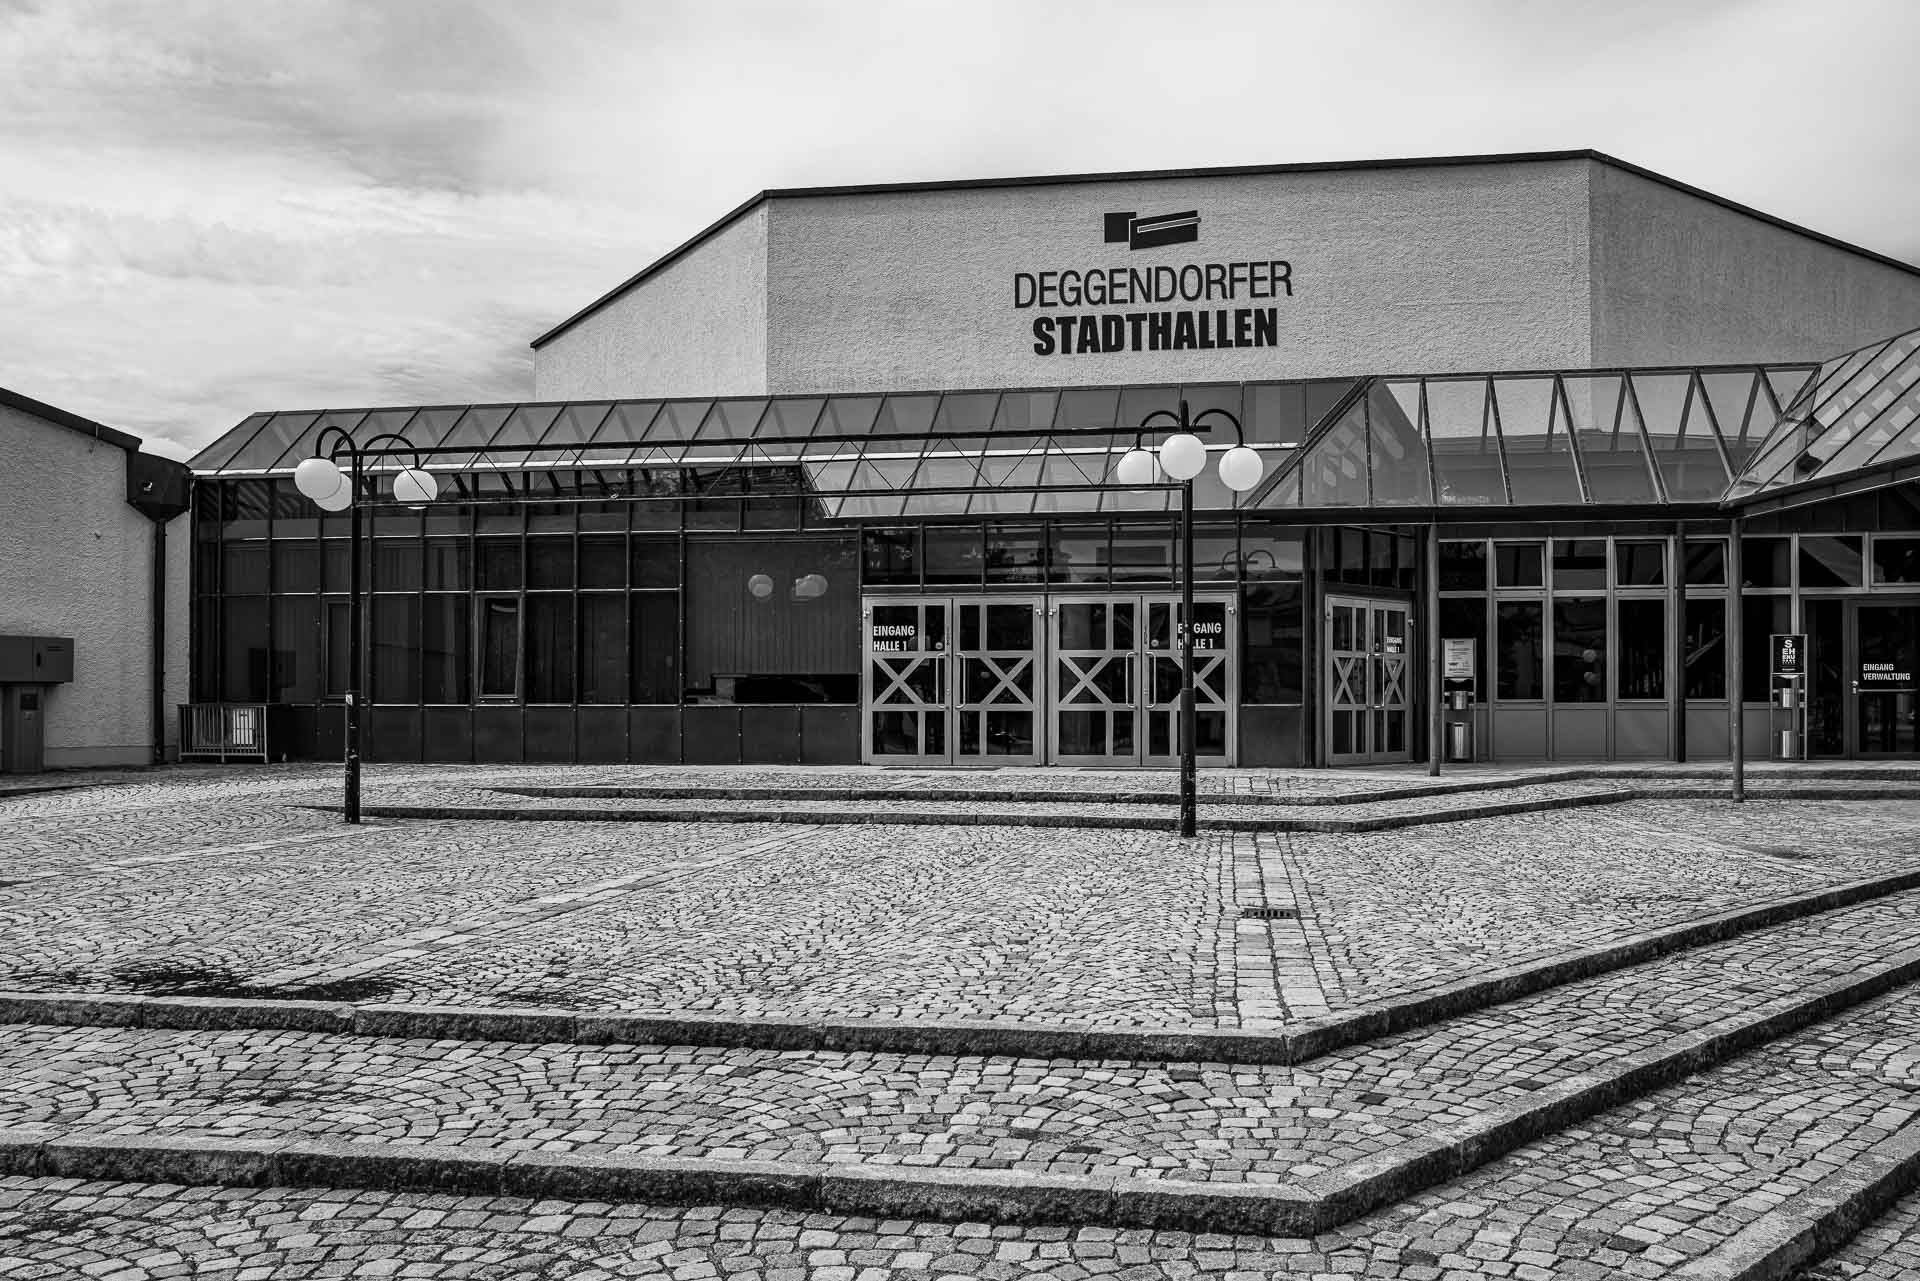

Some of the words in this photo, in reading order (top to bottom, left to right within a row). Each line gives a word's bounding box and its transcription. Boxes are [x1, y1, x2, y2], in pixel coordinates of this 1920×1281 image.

[1014, 260, 1294, 309] DEGGENDORFER
[1033, 307, 1278, 356] STADTHALLEN
[873, 625, 915, 636] EINGANG
[1177, 622, 1222, 634] EGANG
[873, 640, 900, 651] HALLE
[902, 640, 908, 651] 1
[1177, 638, 1206, 649] HLE
[1209, 638, 1214, 649] 1
[1784, 639, 1793, 649] S
[1863, 663, 1894, 671] EINGANG
[1863, 672, 1911, 680] VERWALTUNG
